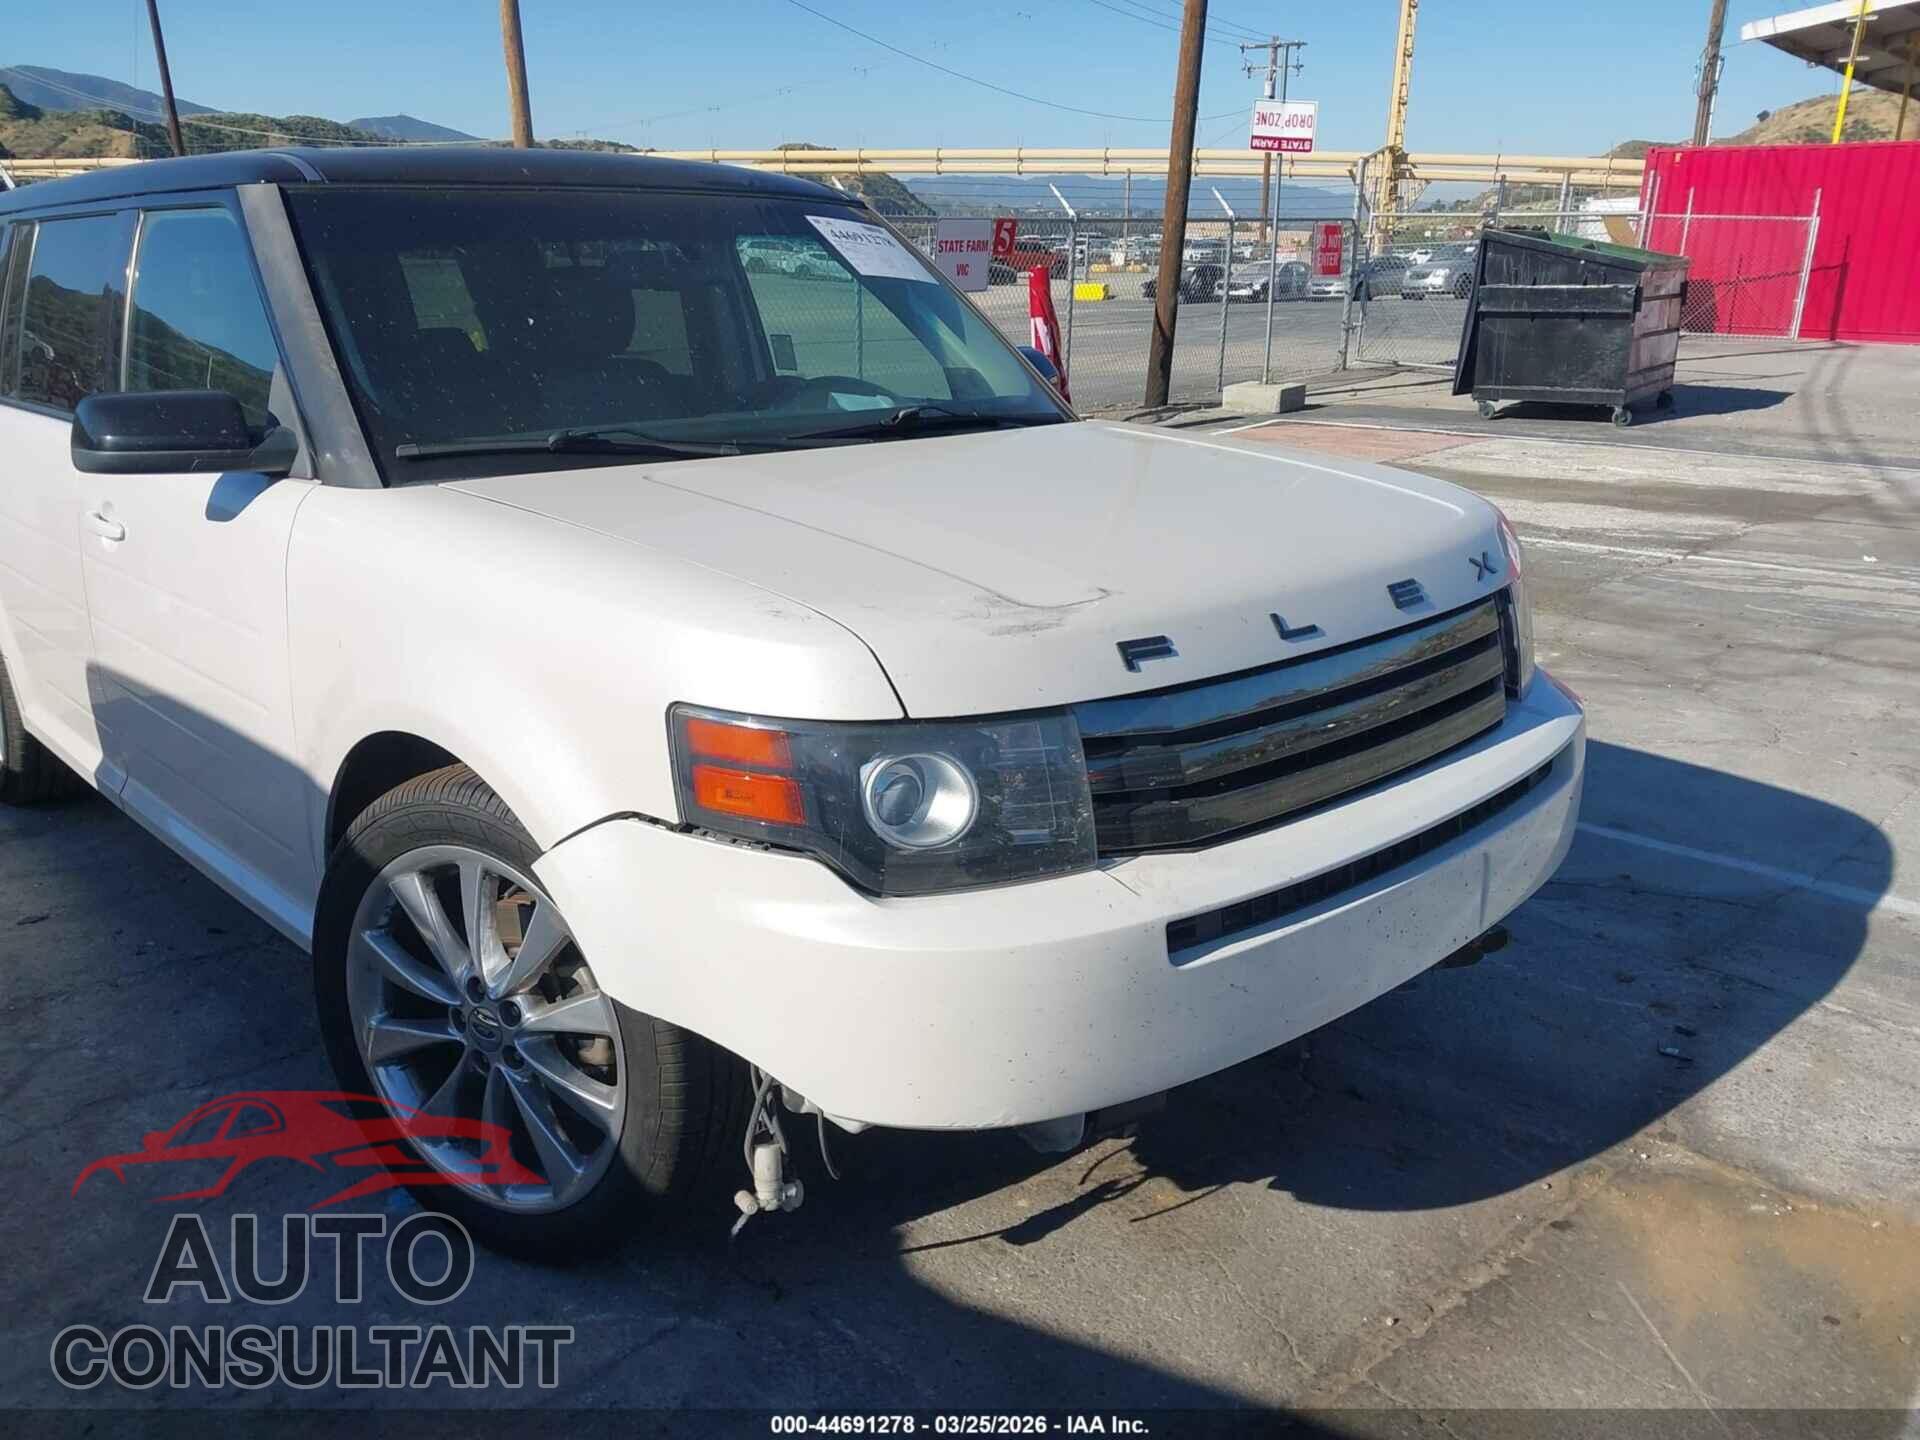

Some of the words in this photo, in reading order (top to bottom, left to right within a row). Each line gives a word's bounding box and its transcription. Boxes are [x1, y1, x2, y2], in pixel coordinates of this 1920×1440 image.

[1255, 111, 1281, 127] ZONE
[1284, 113, 1313, 128] DROP
[1252, 138, 1280, 148] FARM
[1280, 140, 1312, 150] STATE
[997, 221, 1012, 252] 5
[938, 240, 965, 253] STATE
[966, 240, 989, 252] FARM
[956, 263, 970, 277] VIC
[1116, 551, 1498, 673] FLEX
